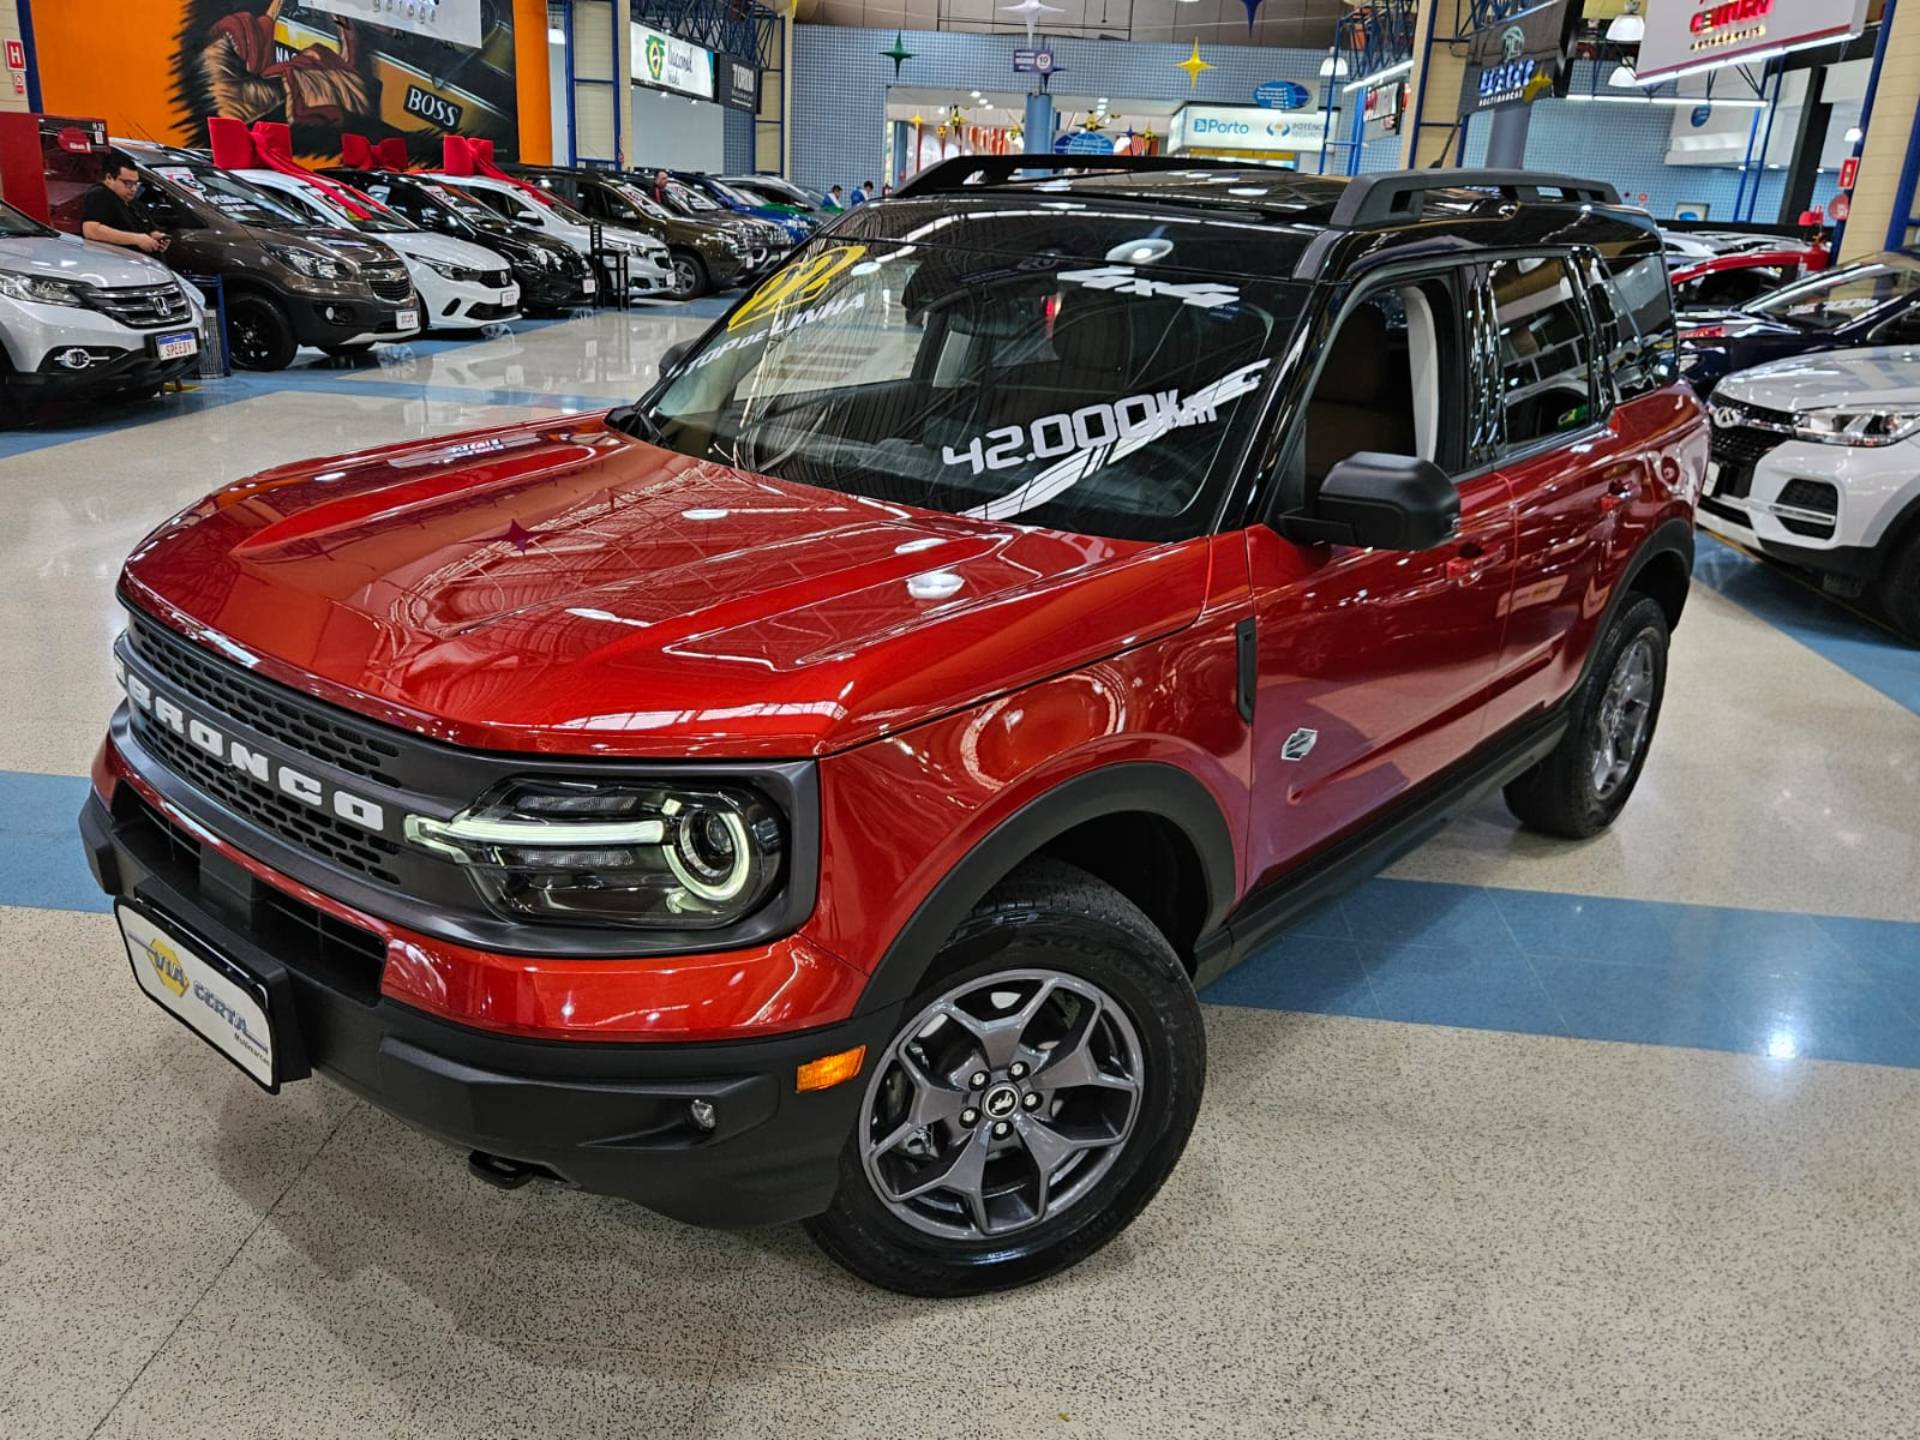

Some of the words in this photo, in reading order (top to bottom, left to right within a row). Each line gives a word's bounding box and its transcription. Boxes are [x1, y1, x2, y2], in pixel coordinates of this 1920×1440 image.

[407, 87, 459, 127] BOSS
[1208, 118, 1249, 134] Porto
[737, 328, 769, 349] DE
[770, 292, 866, 337] LINHA
[127, 673, 384, 831] BRONCO
[154, 951, 185, 987] VIA
[193, 979, 249, 1035] CERTA
